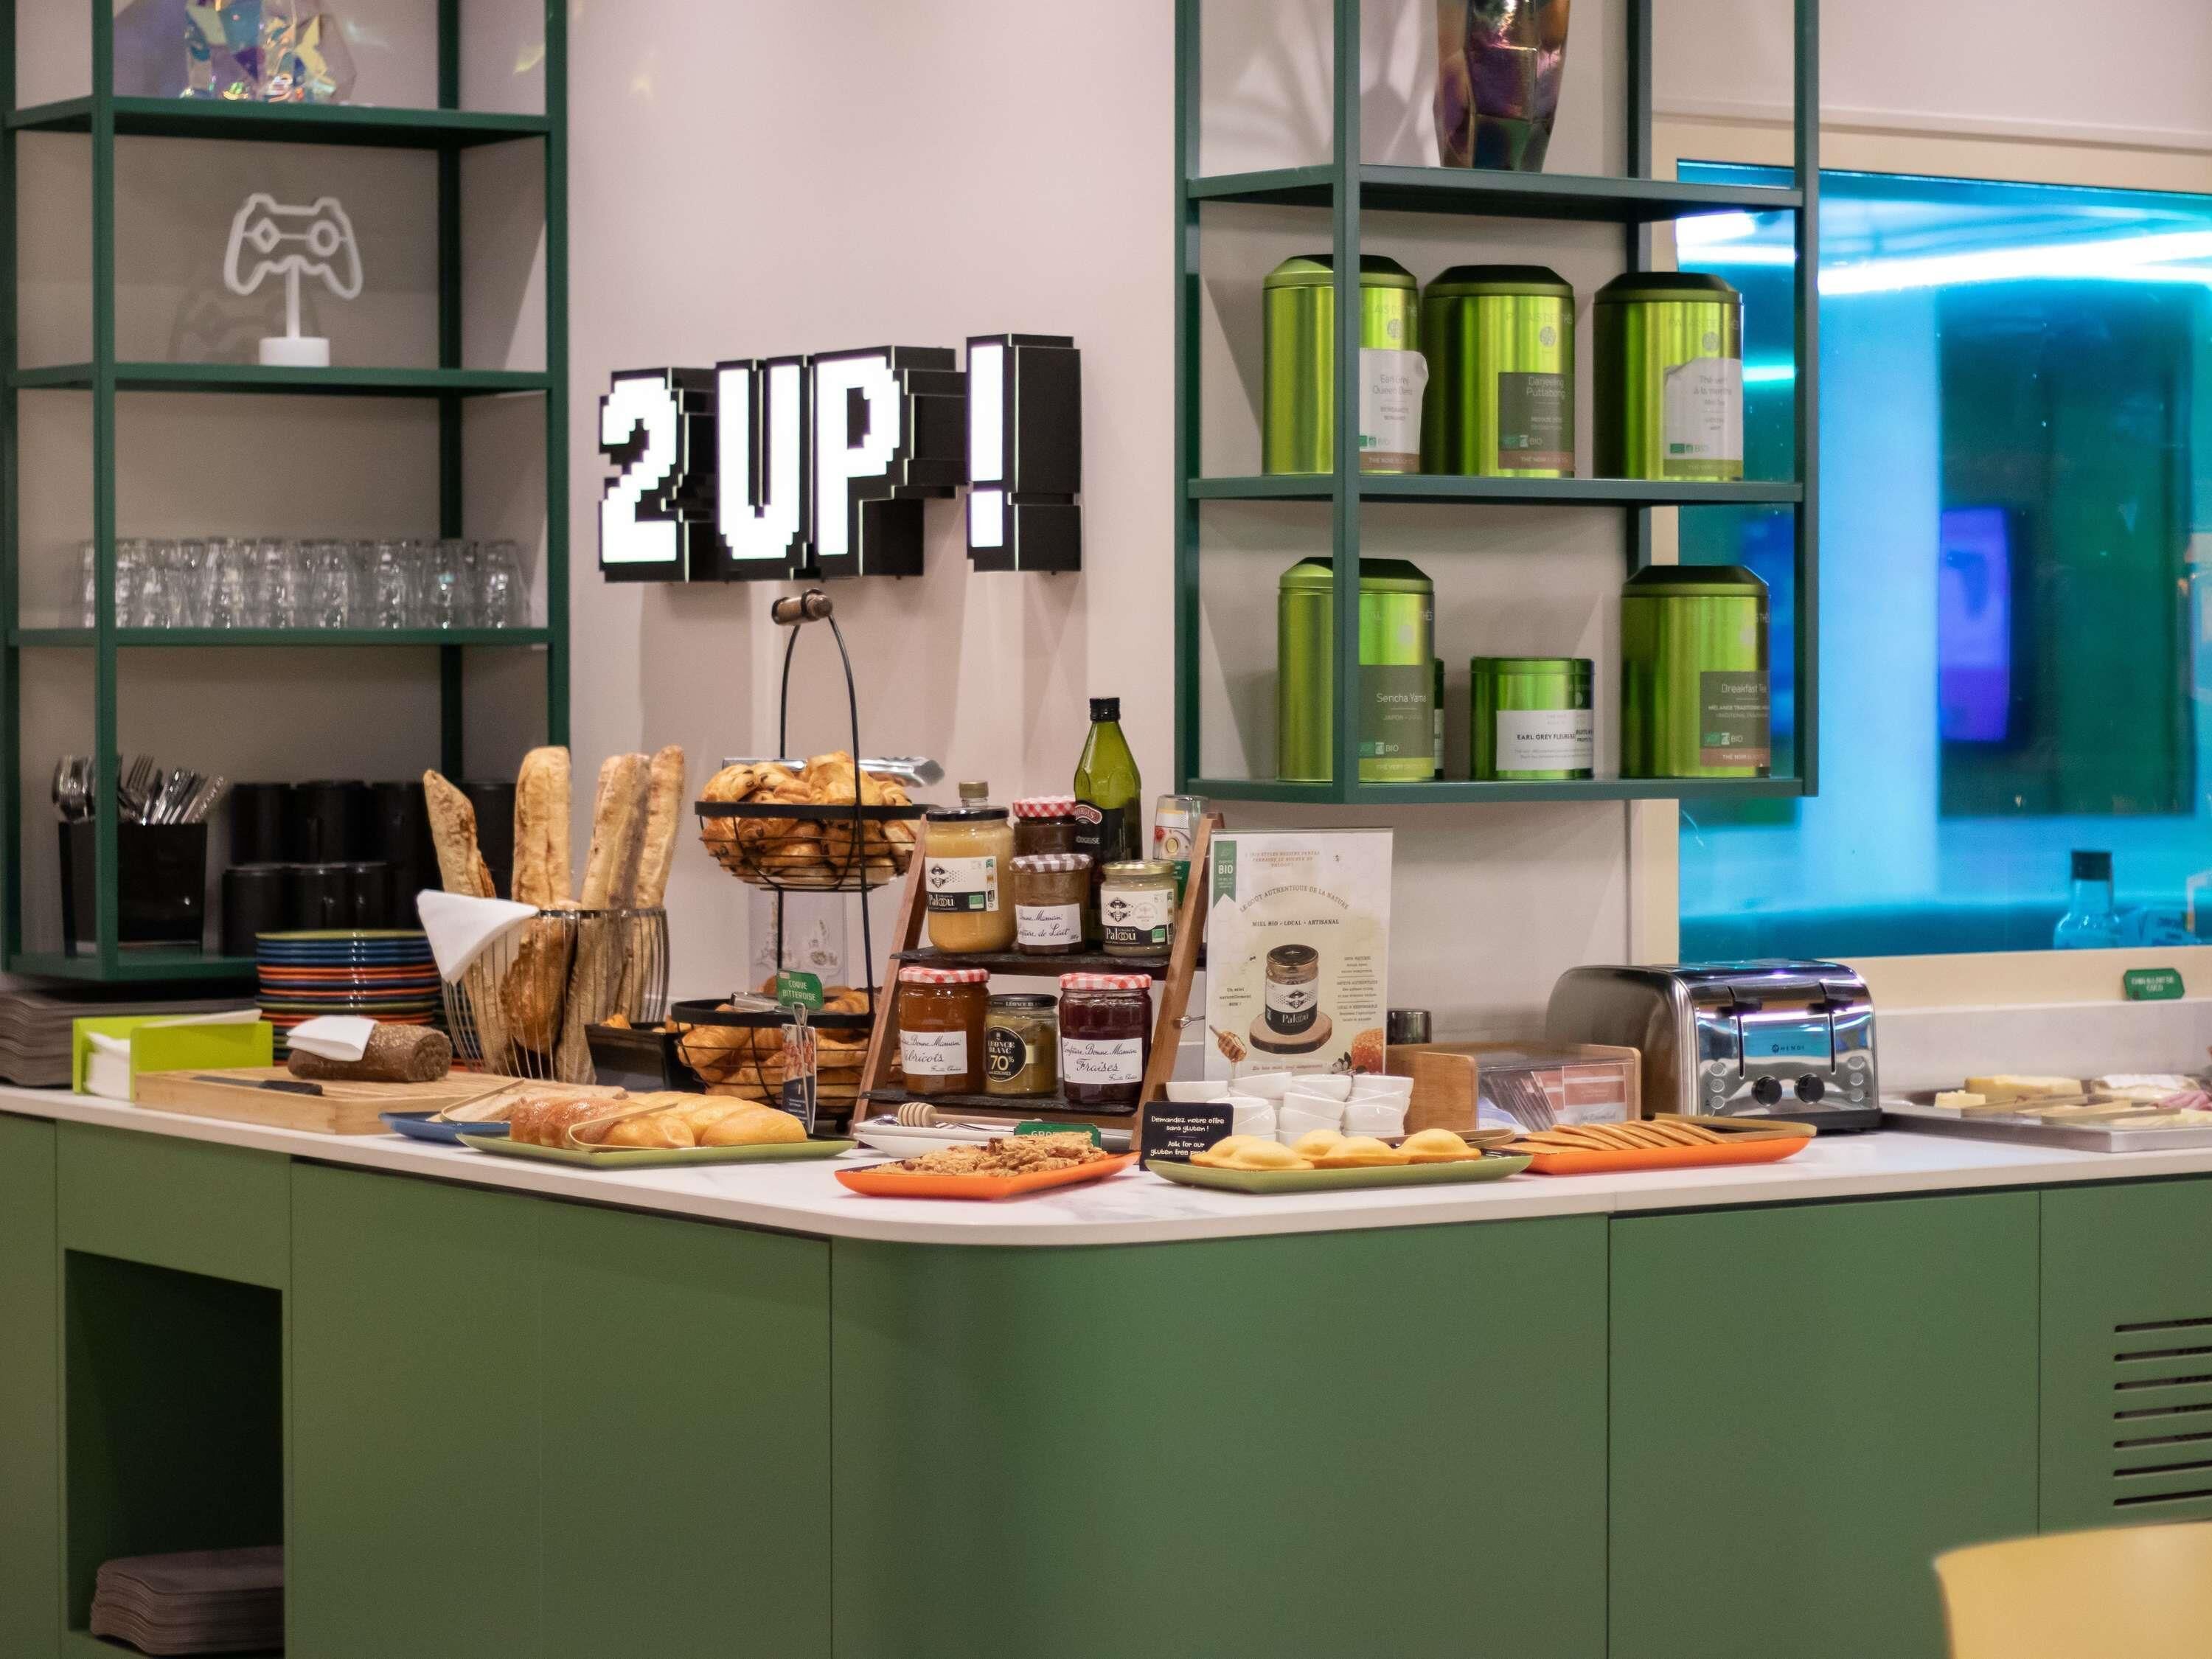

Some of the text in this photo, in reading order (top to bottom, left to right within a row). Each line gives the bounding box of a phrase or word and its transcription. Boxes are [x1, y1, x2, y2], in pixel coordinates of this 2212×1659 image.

[599, 370, 687, 581] 2
[717, 348, 913, 578] UP
[1377, 693, 1409, 702] Sencha
[1218, 865, 1234, 874] BIO
[1239, 904, 1248, 913] LE
[1264, 885, 1307, 898] AUTHENTIQUE
[1318, 888, 1326, 897] LA
[1326, 891, 1349, 910] NATURE
[1034, 909, 1063, 922] Maman
[930, 1034, 962, 1047] Maman
[1085, 1043, 1109, 1055] Bonne
[1110, 1043, 1138, 1055] Maman
[1076, 1057, 1121, 1073] Fraises
